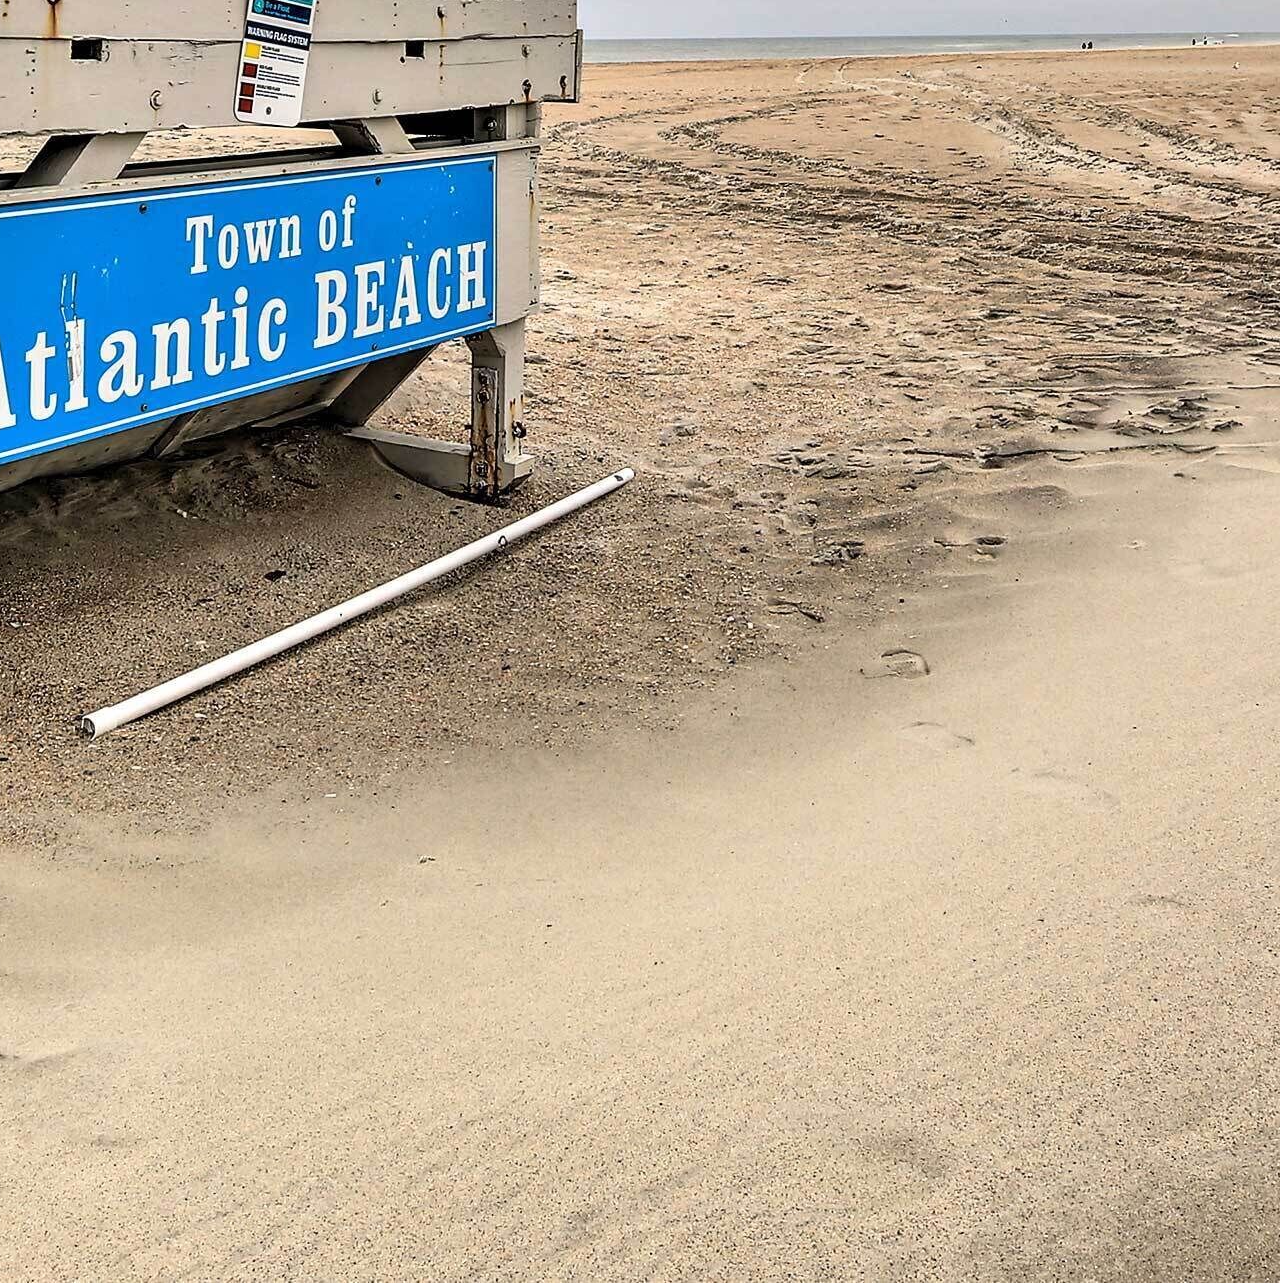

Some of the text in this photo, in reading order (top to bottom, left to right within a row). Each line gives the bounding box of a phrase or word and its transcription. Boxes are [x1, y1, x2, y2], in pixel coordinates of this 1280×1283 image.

[247, 26, 308, 46] WARNING FLAG SYSTEM
[186, 195, 357, 275] Town of
[314, 240, 488, 349] BEACH
